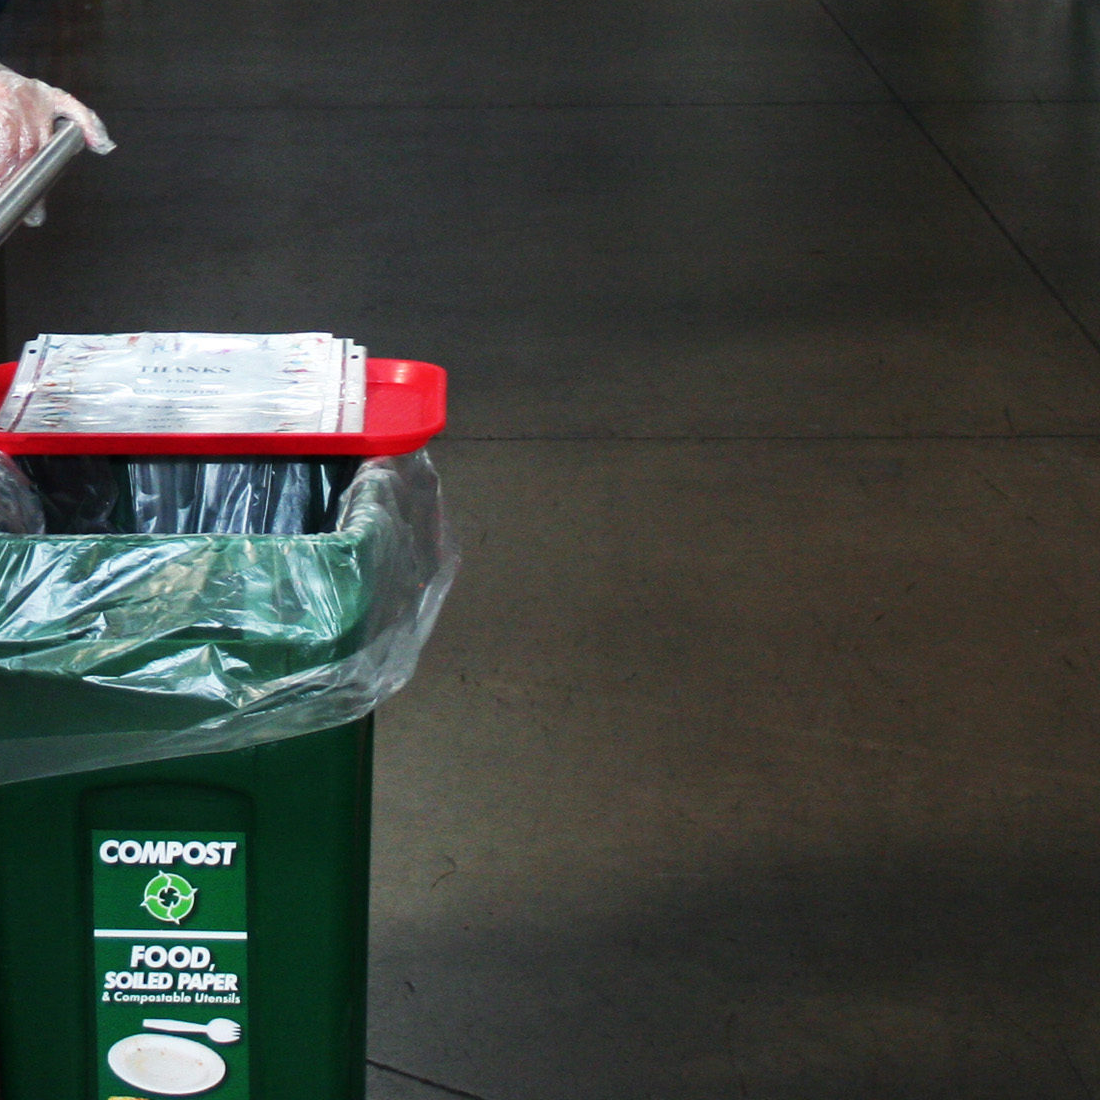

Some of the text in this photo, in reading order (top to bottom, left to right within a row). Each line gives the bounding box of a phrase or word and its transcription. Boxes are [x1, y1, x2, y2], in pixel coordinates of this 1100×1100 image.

[139, 366, 231, 374] THANKS
[99, 839, 237, 867] COMPOST
[130, 945, 215, 972] FOOD,
[103, 971, 239, 991] SOILED PAPER
[102, 991, 241, 1005] & Compostable Utensils
